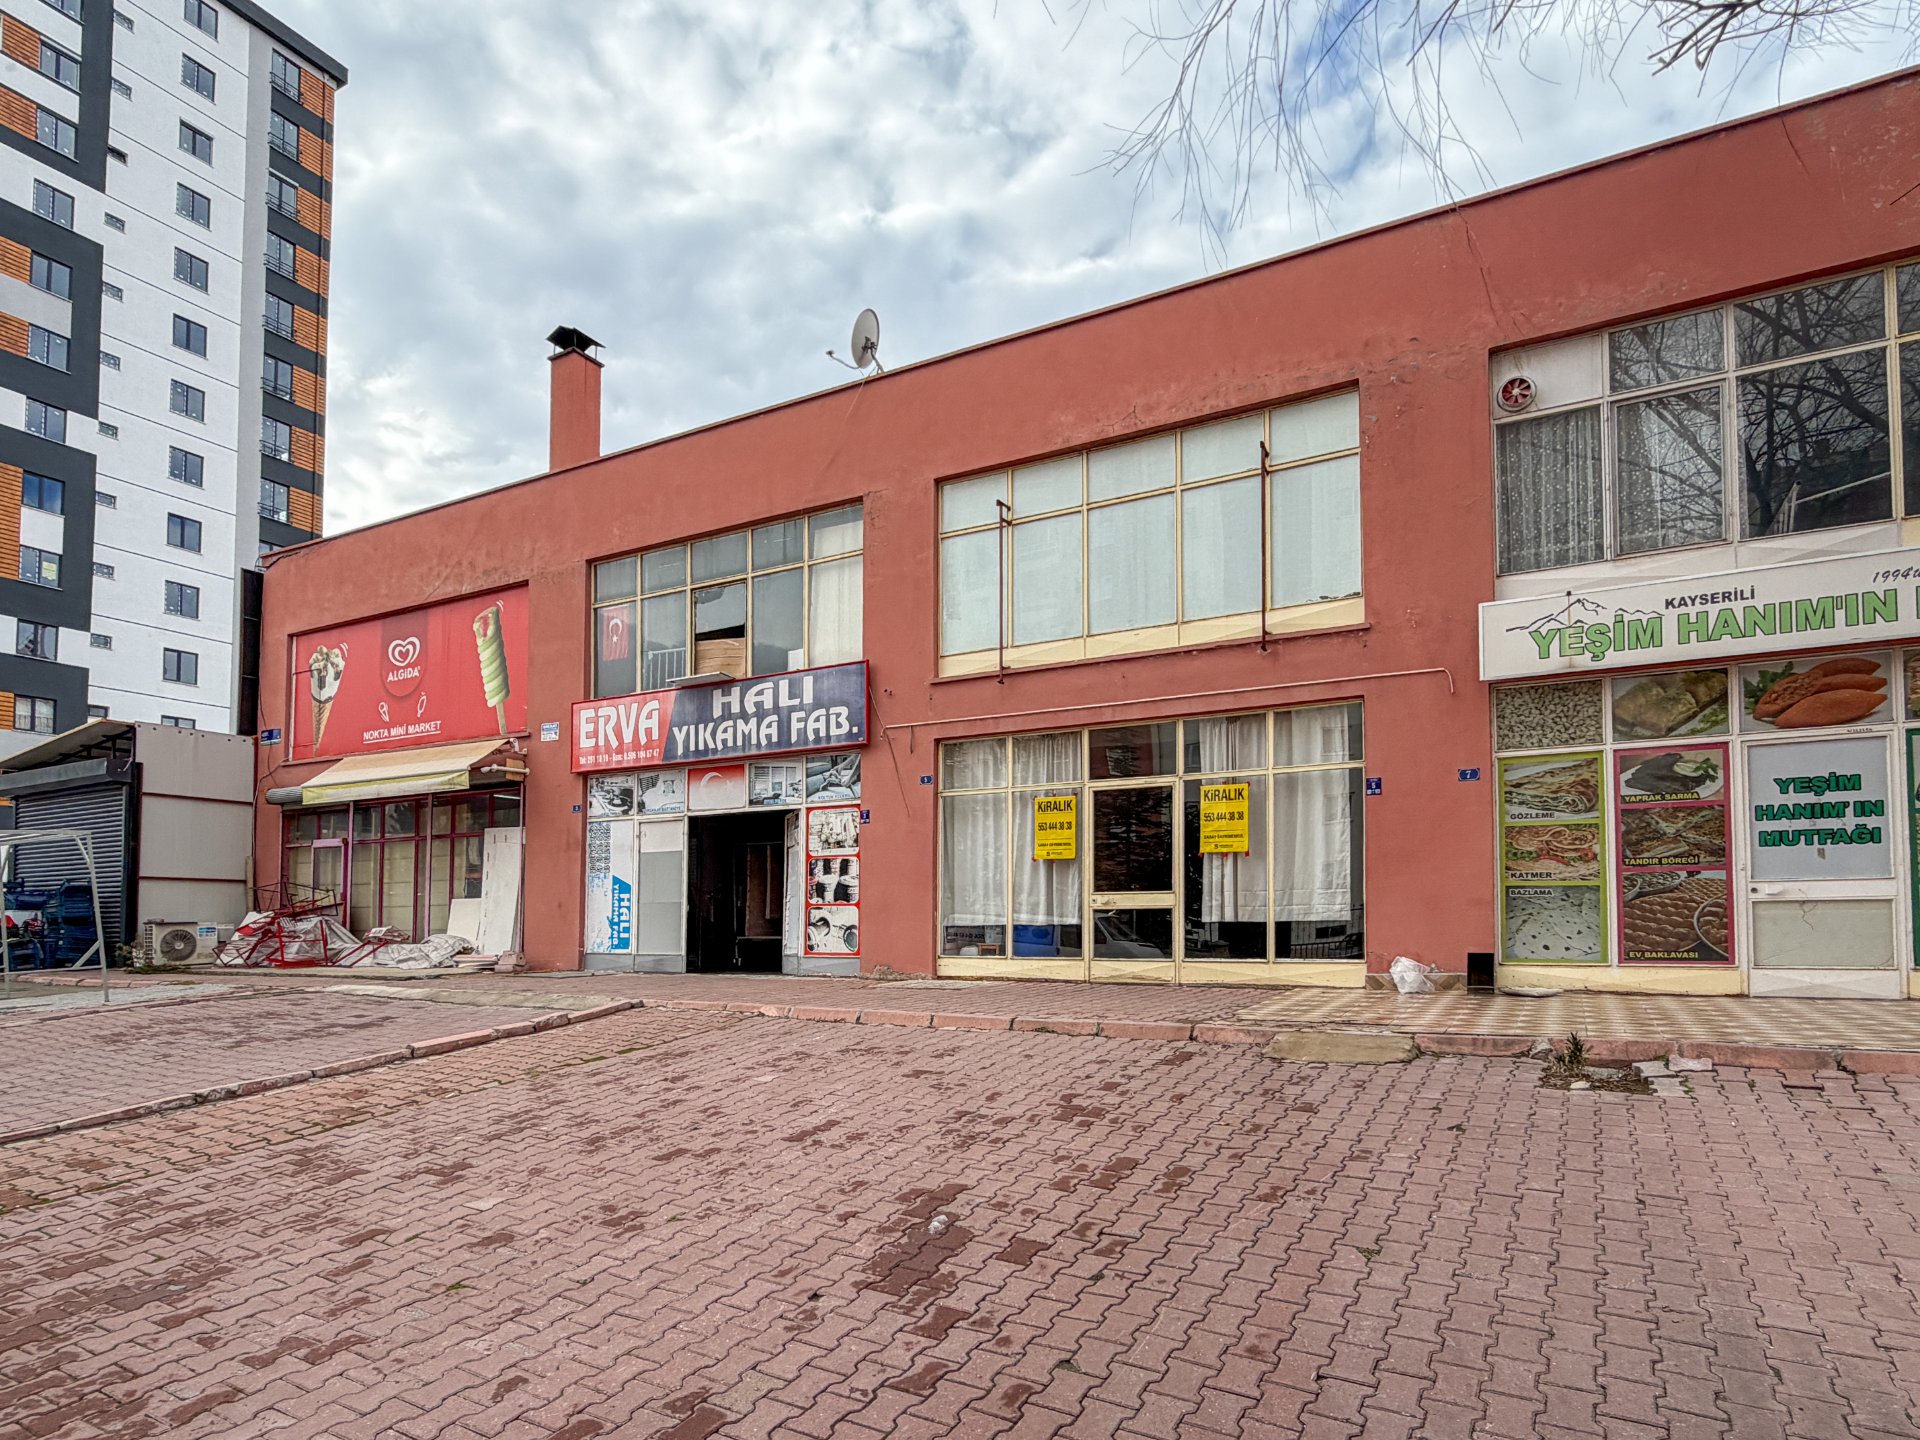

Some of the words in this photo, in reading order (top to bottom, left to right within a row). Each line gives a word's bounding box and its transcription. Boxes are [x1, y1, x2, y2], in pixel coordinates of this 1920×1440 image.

[1664, 585, 1756, 610] KAYSERİLİ
[1529, 614, 1663, 662] YEŞİM
[1677, 588, 1899, 645] HANIM'IN
[712, 675, 814, 719] HALI
[363, 728, 388, 740] NOKTA
[408, 720, 442, 733] MARKET
[579, 699, 660, 750] ERVA
[672, 714, 779, 756] YIKAMA
[790, 705, 860, 744] FAB.
[1466, 770, 1472, 779] 7
[1773, 771, 1862, 796] YEŞİM
[1624, 793, 1662, 803] YAPRAK
[1664, 792, 1699, 801] SARMA
[1510, 811, 1556, 821] GÖZLEME
[1759, 823, 1882, 847] MUTFAĞI
[1624, 857, 1660, 866] TANDIR
[1661, 855, 1699, 865] BÖREĞİ
[1510, 871, 1553, 879] KATMER
[619, 892, 631, 938] HALI
[1629, 951, 1642, 959] EV
[1644, 950, 1699, 959] BAKLAVASI
